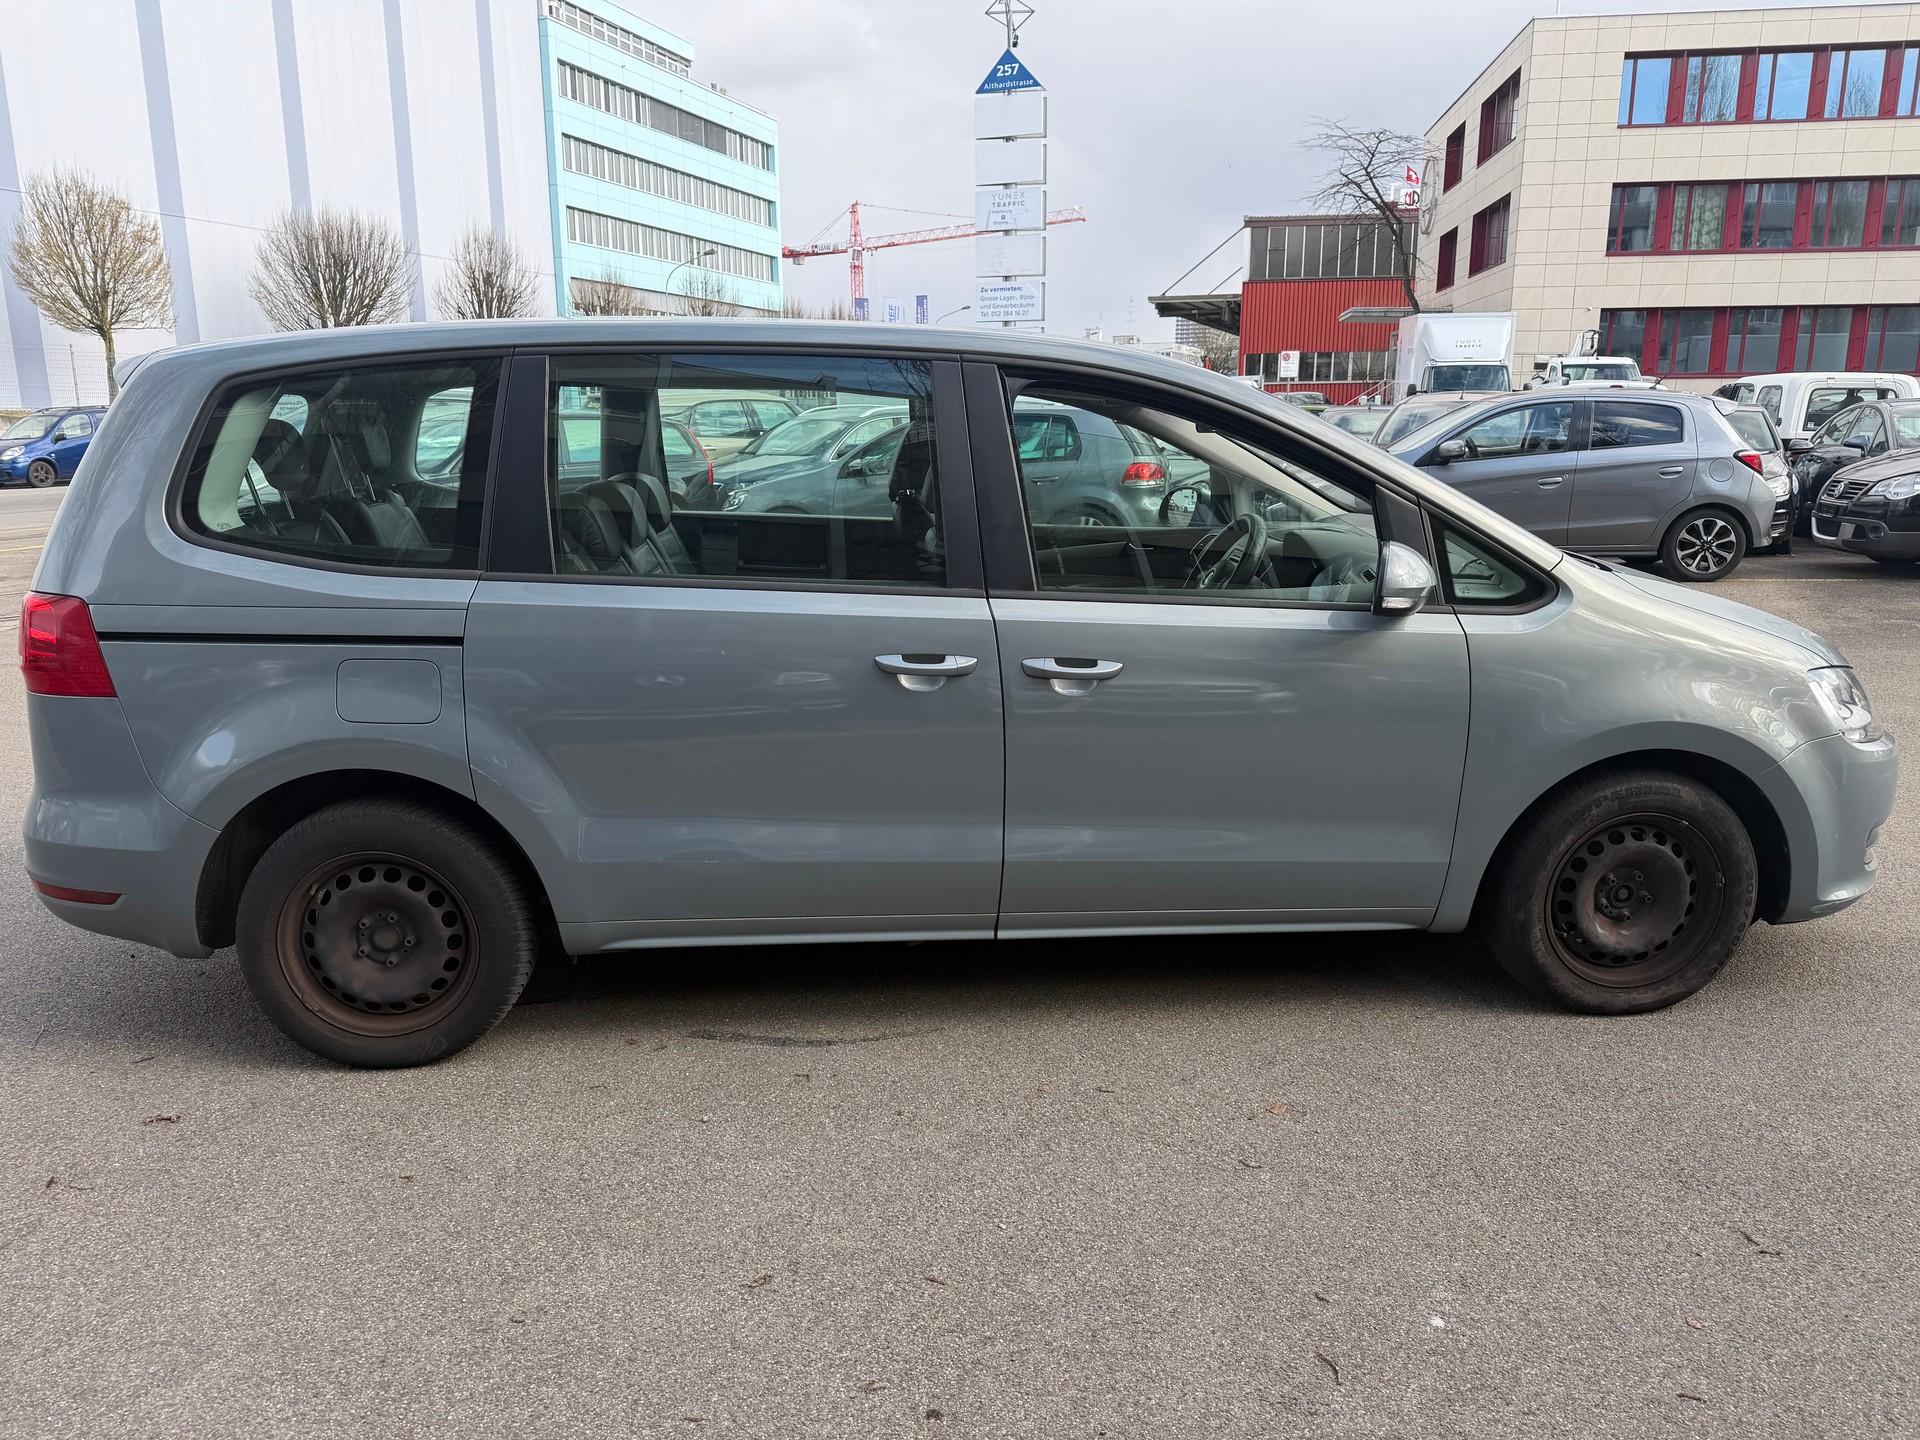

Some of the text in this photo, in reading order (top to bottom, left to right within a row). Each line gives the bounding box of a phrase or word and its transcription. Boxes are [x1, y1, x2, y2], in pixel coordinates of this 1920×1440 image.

[996, 63, 1020, 77] 257
[983, 79, 1034, 90] Althardstrasse
[991, 191, 1026, 201] YUNEX
[991, 200, 1026, 208] TRAFFIC
[990, 285, 1023, 293] vermieten:
[992, 302, 1035, 310] Gewerberäume
